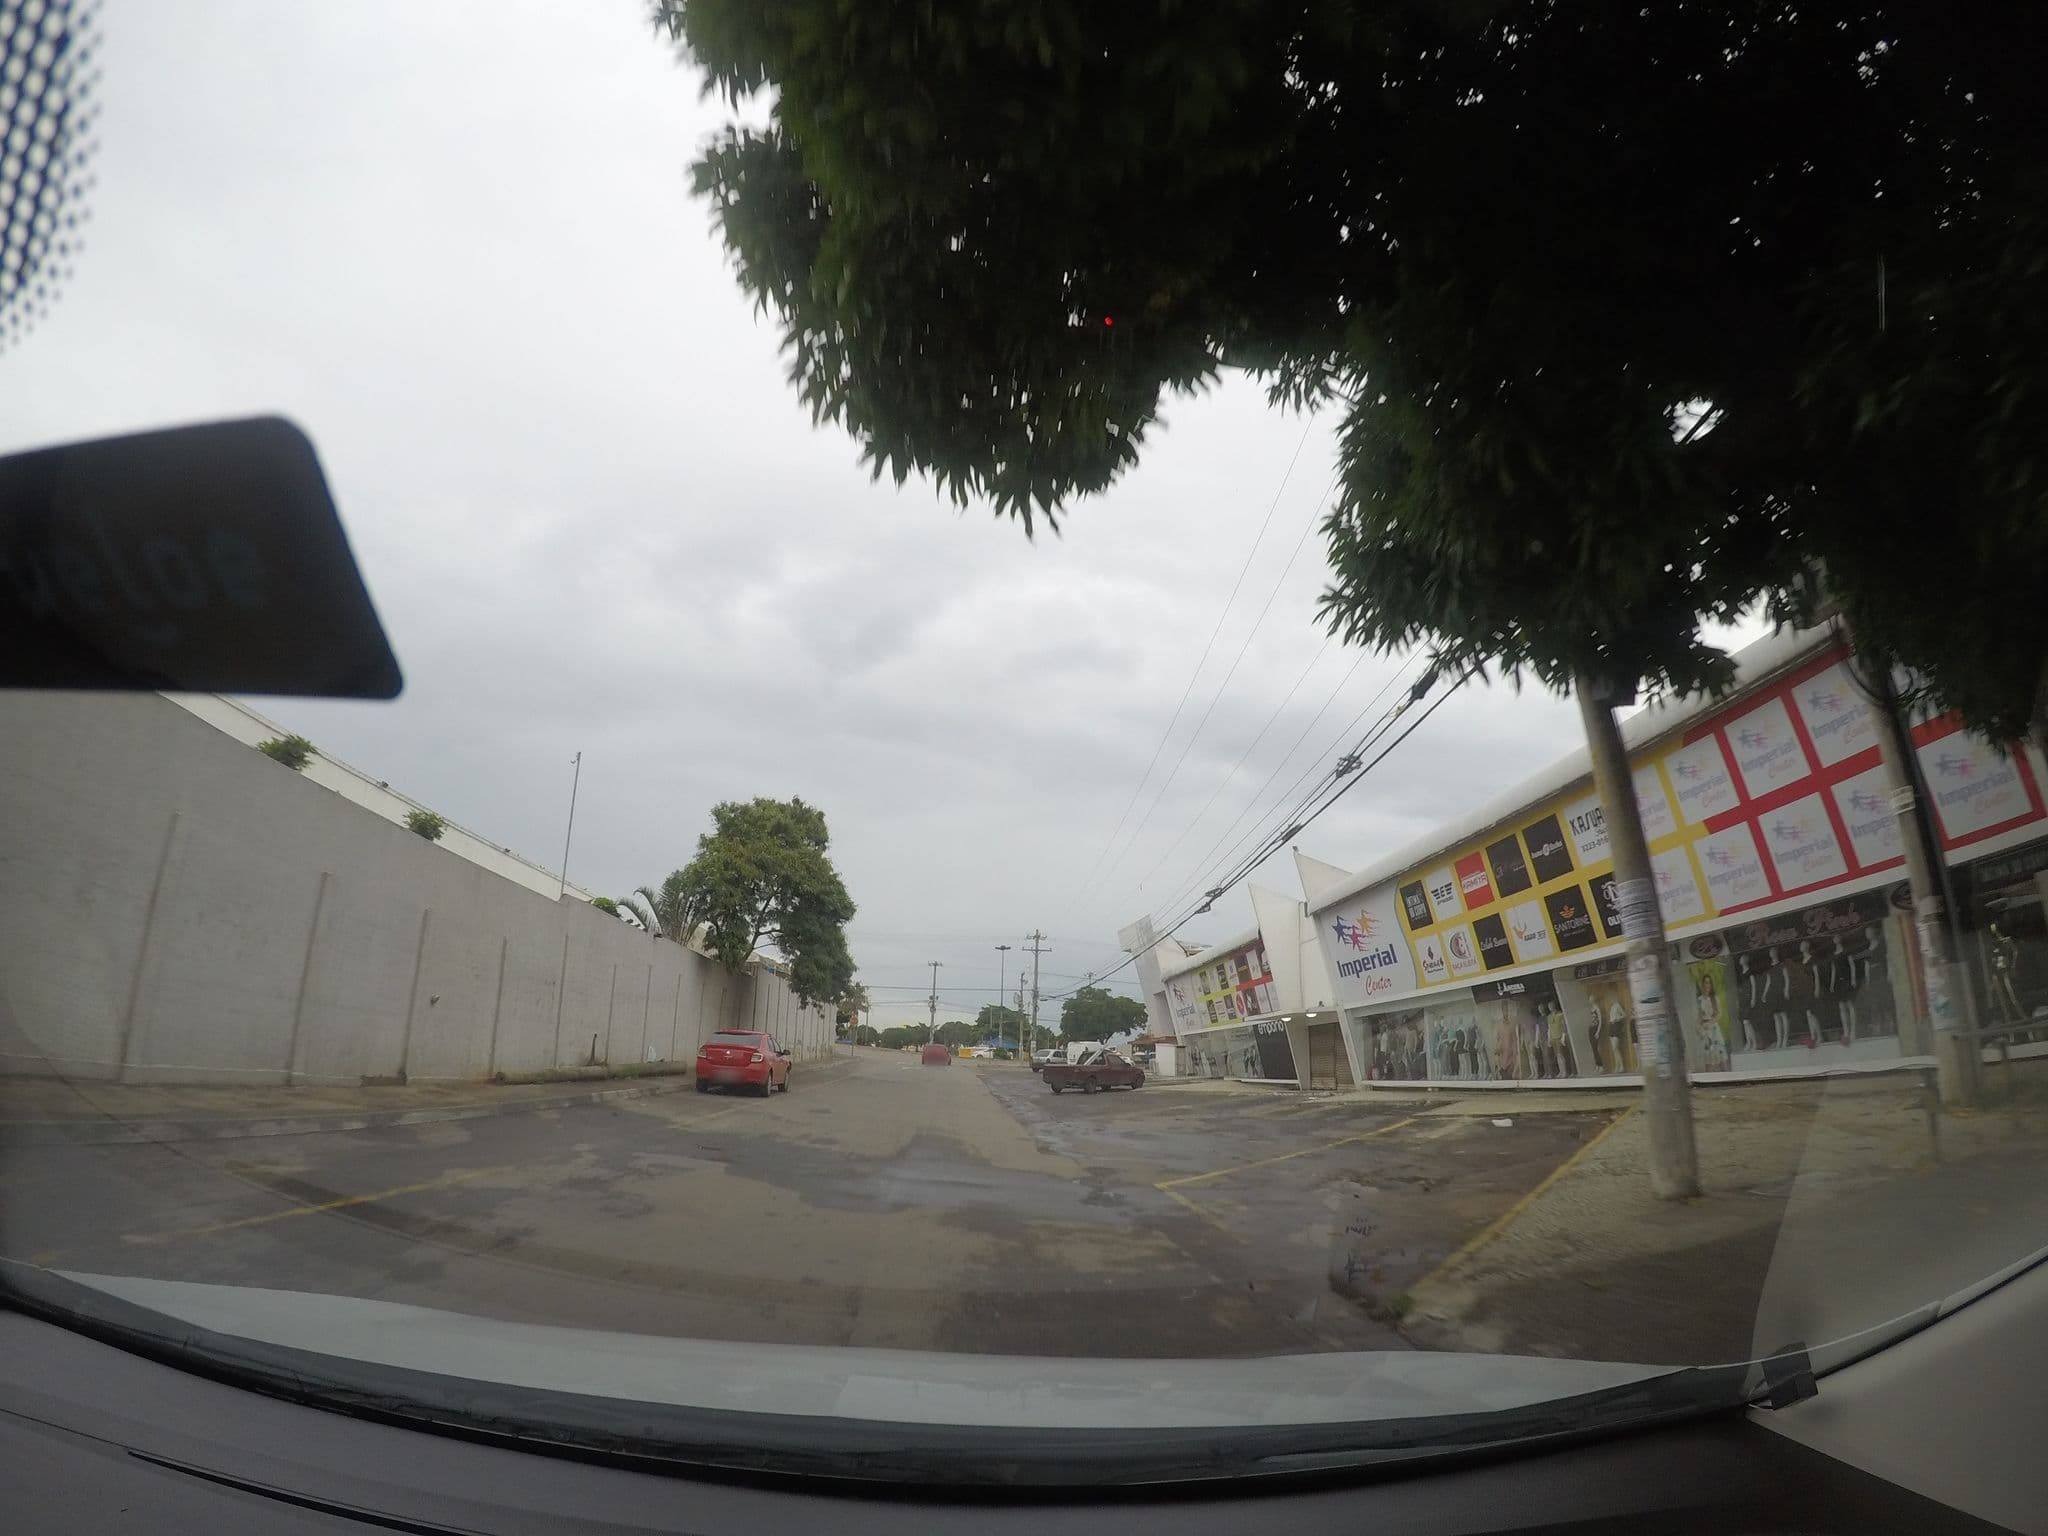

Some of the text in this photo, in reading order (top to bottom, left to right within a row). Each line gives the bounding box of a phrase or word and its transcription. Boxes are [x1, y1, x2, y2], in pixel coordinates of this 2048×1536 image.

[1739, 737, 1797, 775] Imperial
[1677, 772, 1727, 802] Imperial
[1773, 834, 1833, 865] Imperial
[1706, 861, 1760, 887] Imperial
[1663, 880, 1695, 904] perial
[1336, 943, 1398, 979] Imperial
[1365, 974, 1392, 996] Center
